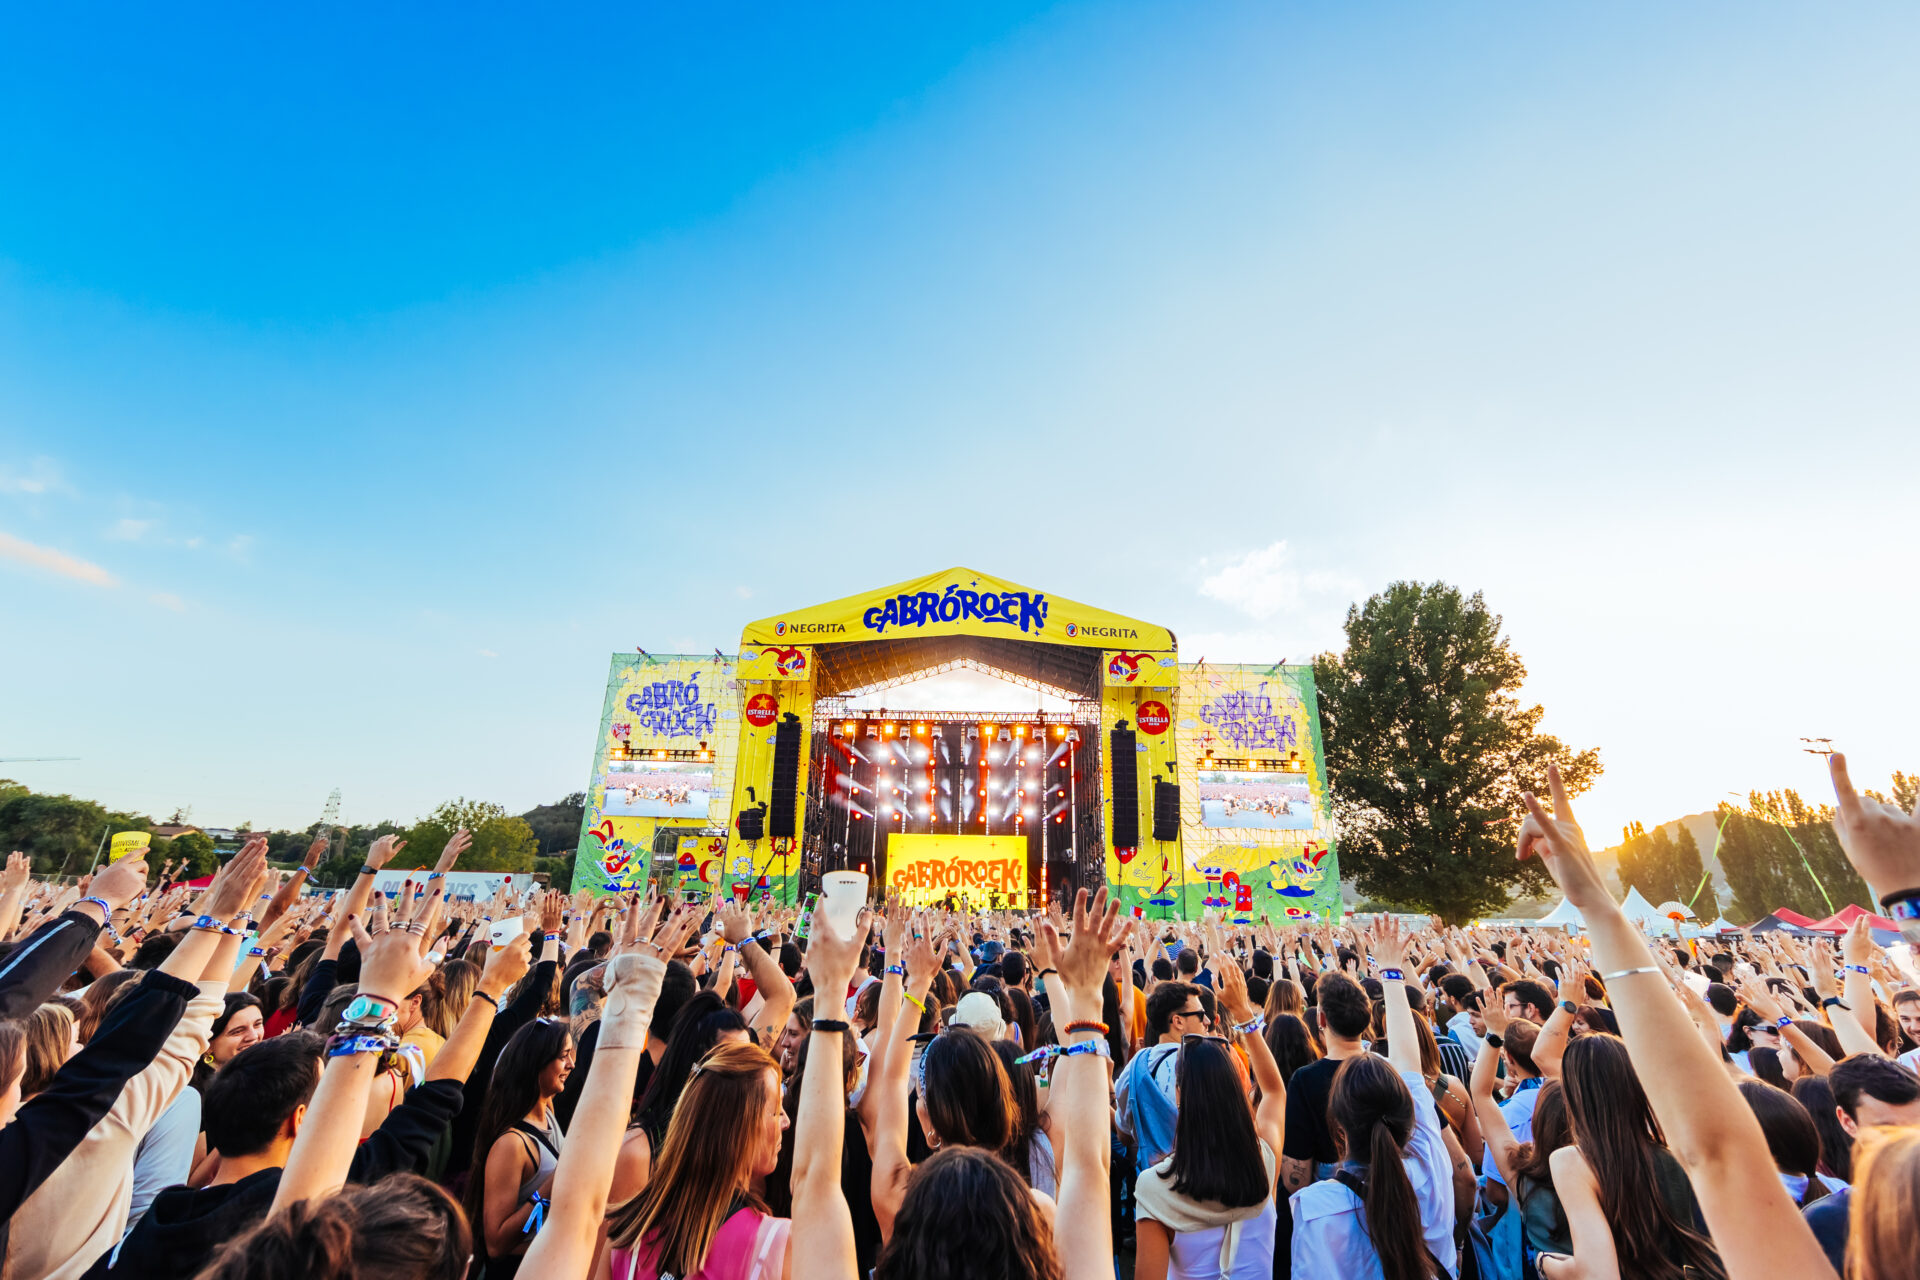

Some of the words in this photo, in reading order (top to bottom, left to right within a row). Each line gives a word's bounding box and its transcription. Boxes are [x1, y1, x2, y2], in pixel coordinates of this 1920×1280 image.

[790, 623, 846, 633] NEGRITA
[1081, 626, 1138, 639] NEGRITA
[626, 671, 700, 716] CABRÓ
[1199, 682, 1272, 727] CABRÓ
